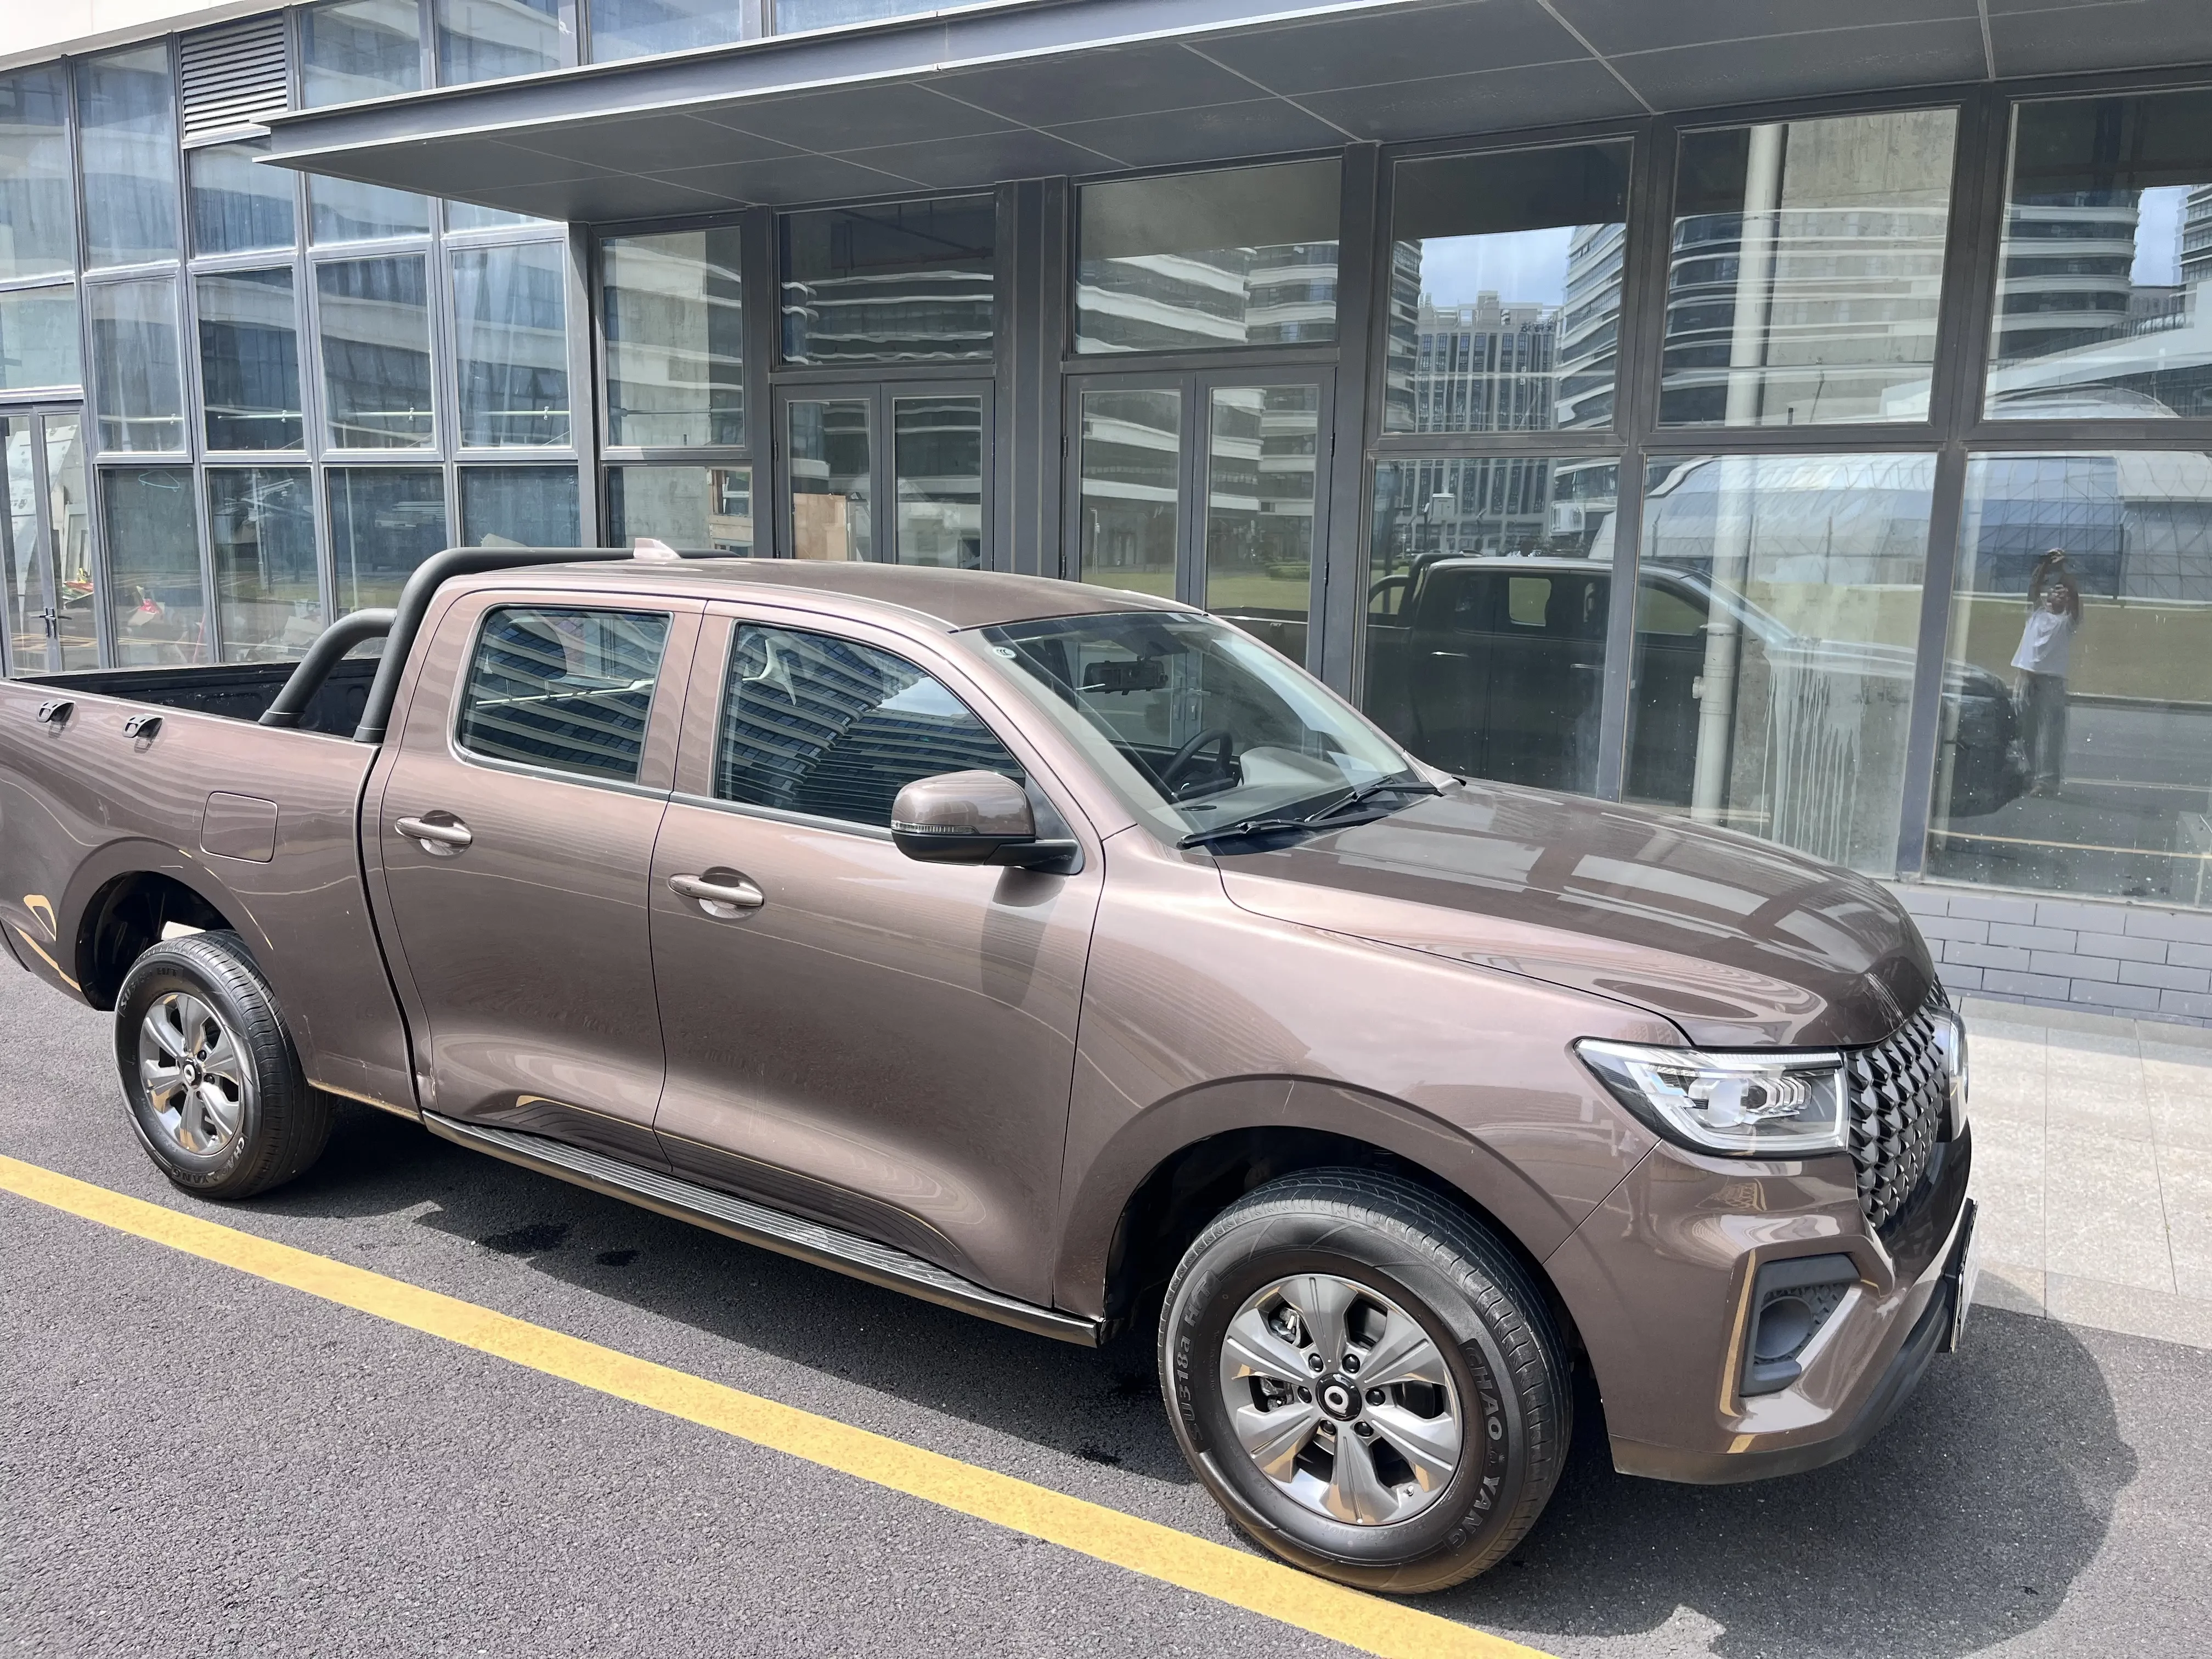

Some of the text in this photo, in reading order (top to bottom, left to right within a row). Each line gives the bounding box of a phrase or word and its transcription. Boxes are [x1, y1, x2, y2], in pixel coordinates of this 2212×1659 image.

[172, 1169, 209, 1184] YANG
[1176, 1280, 1211, 1442] SU318a H/T
[1447, 1346, 1503, 1549] CHAO YANG
